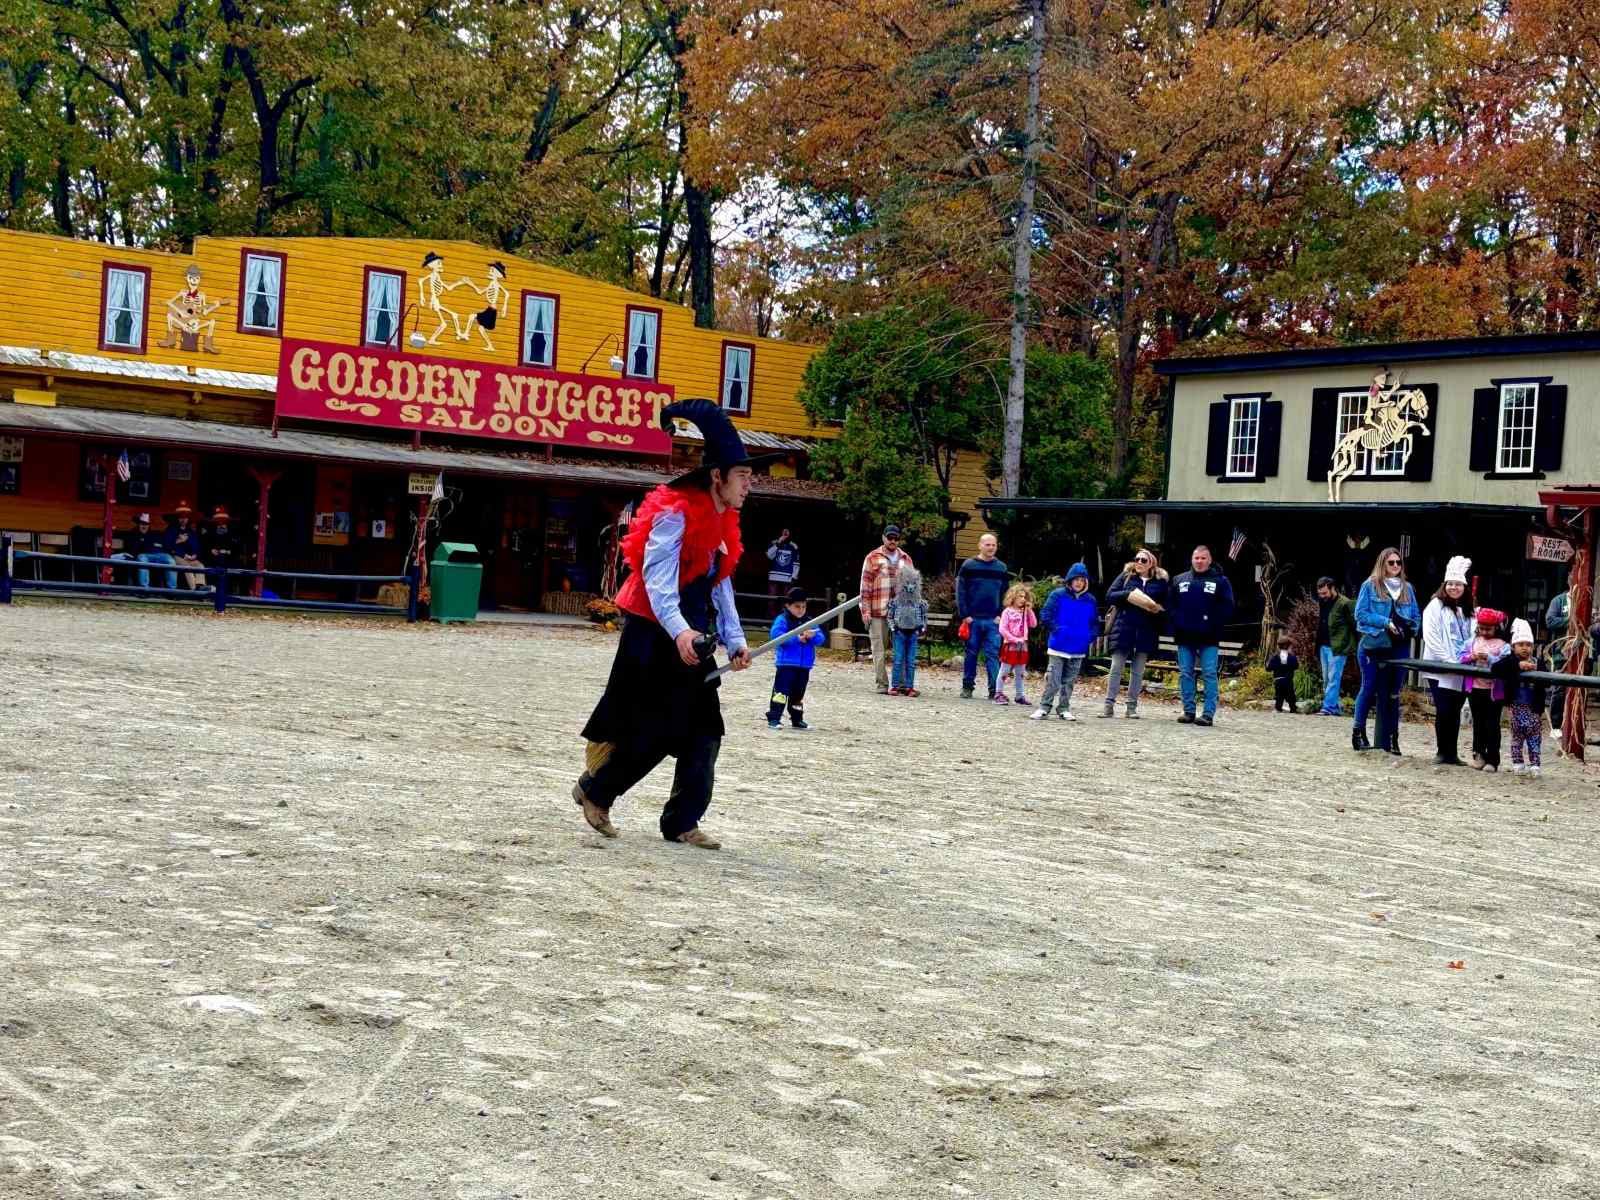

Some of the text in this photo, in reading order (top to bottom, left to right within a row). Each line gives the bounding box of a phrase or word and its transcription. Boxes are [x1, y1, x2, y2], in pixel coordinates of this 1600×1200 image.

[290, 347, 672, 430] GOLDEN NUGGET
[400, 404, 569, 439] SALOON
[1537, 546, 1567, 560] ROOMS
[1541, 538, 1563, 549] REST
